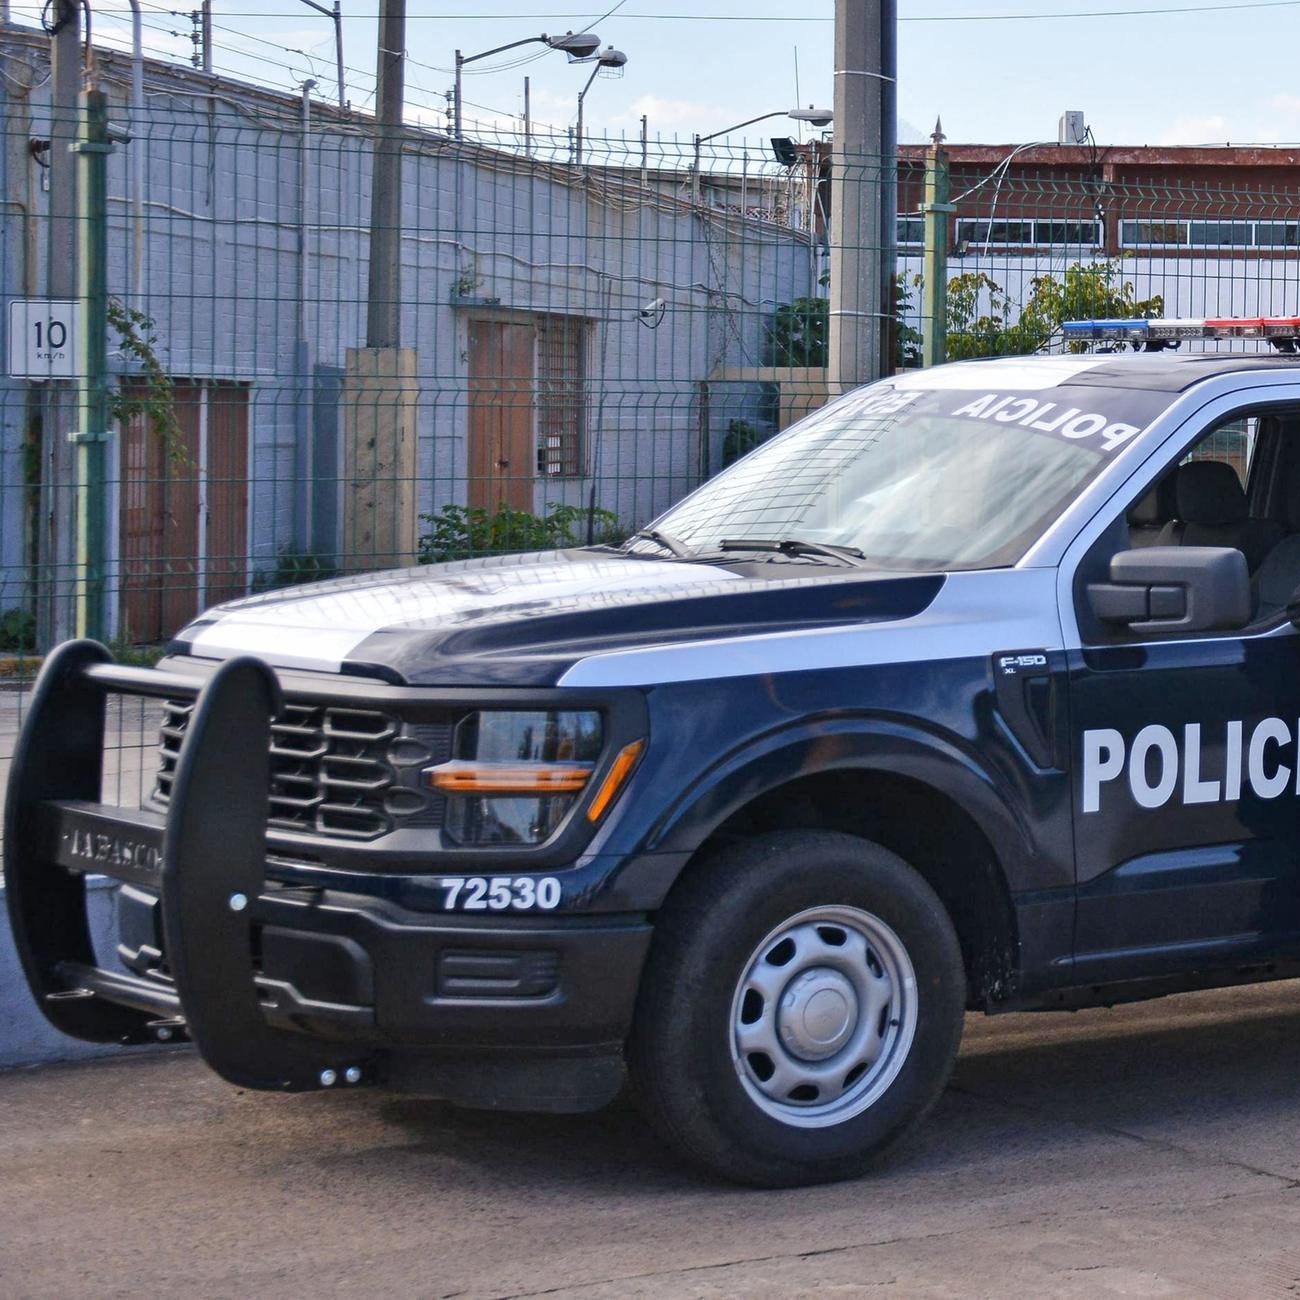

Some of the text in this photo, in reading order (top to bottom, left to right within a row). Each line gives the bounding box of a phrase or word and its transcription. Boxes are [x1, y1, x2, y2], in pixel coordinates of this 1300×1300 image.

[34, 321, 67, 349] 10
[1001, 654, 1047, 668] F-150
[441, 877, 561, 909] 72530
